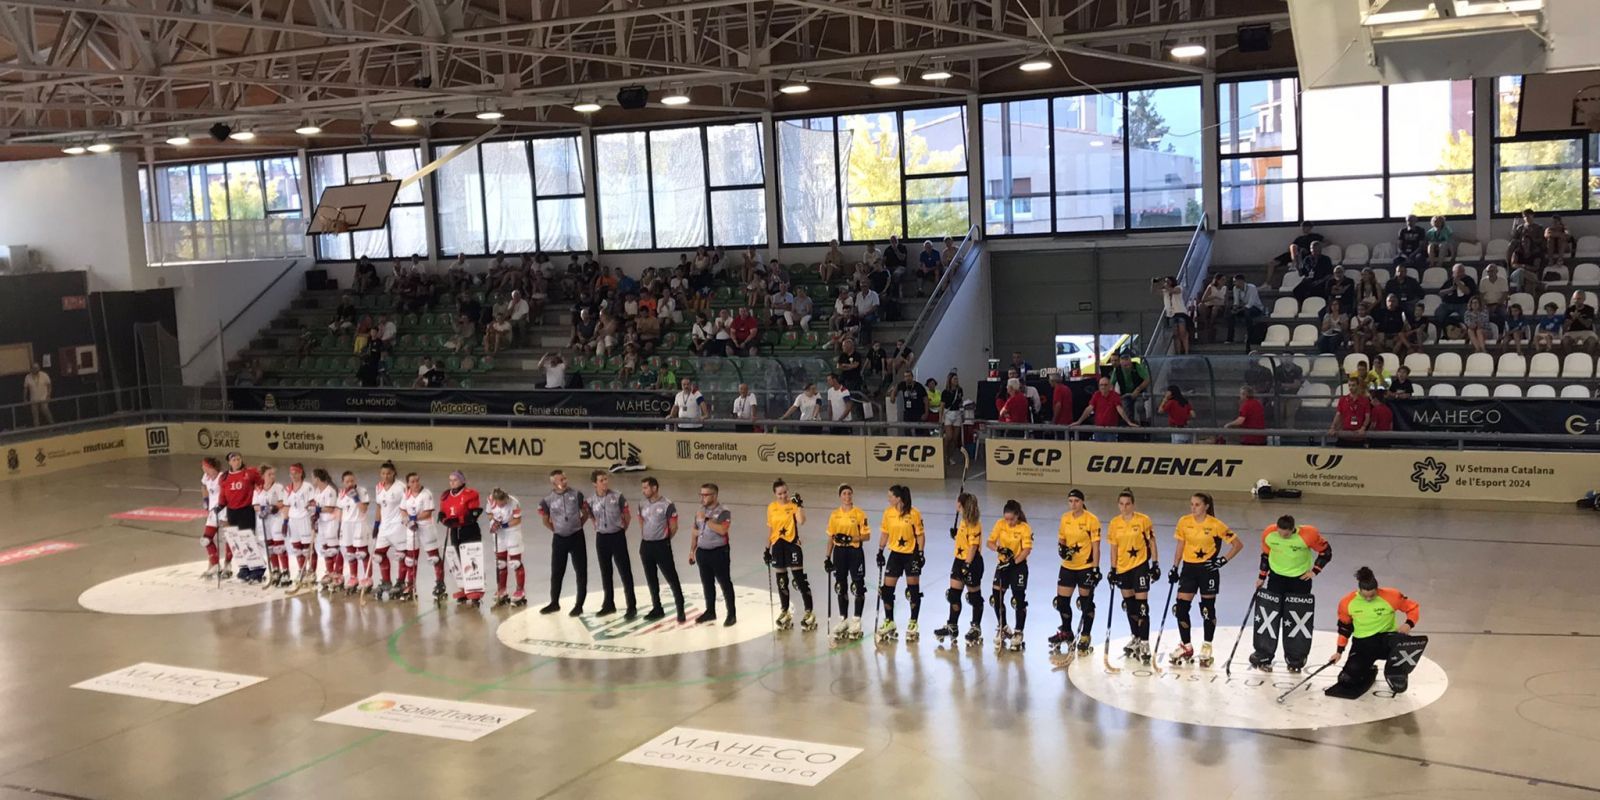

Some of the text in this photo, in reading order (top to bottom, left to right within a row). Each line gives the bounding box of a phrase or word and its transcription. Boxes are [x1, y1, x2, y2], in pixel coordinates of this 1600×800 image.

[616, 400, 671, 412] MAHECO
[1412, 410, 1501, 424] MAHECO
[282, 431, 316, 440] Loteries
[214, 440, 240, 448] SKATE
[284, 441, 324, 452] Catalunya
[381, 438, 434, 452] hockeymania
[465, 437, 543, 456] AZEMAD
[579, 438, 626, 460] 3cat
[694, 441, 738, 451] Generalitat
[706, 452, 747, 463] Catalunya
[778, 450, 852, 466] esportcat
[896, 444, 936, 462] FCP
[1018, 448, 1062, 466] FCP
[1086, 455, 1243, 477] GOLDENCAT
[1456, 464, 1554, 475] IV Setmana Catalana
[230, 482, 242, 490] 10
[1456, 478, 1530, 488] de l'Esport 2024
[450, 507, 456, 516] 1
[792, 552, 798, 562] 5
[1018, 574, 1024, 584] 2
[1140, 576, 1146, 586] 8
[1208, 579, 1215, 589] 9
[1256, 591, 1280, 604] AZEMAD
[399, 704, 502, 724] SolarTradex
[662, 735, 837, 764] MAHECO
[643, 750, 817, 778] constructora
